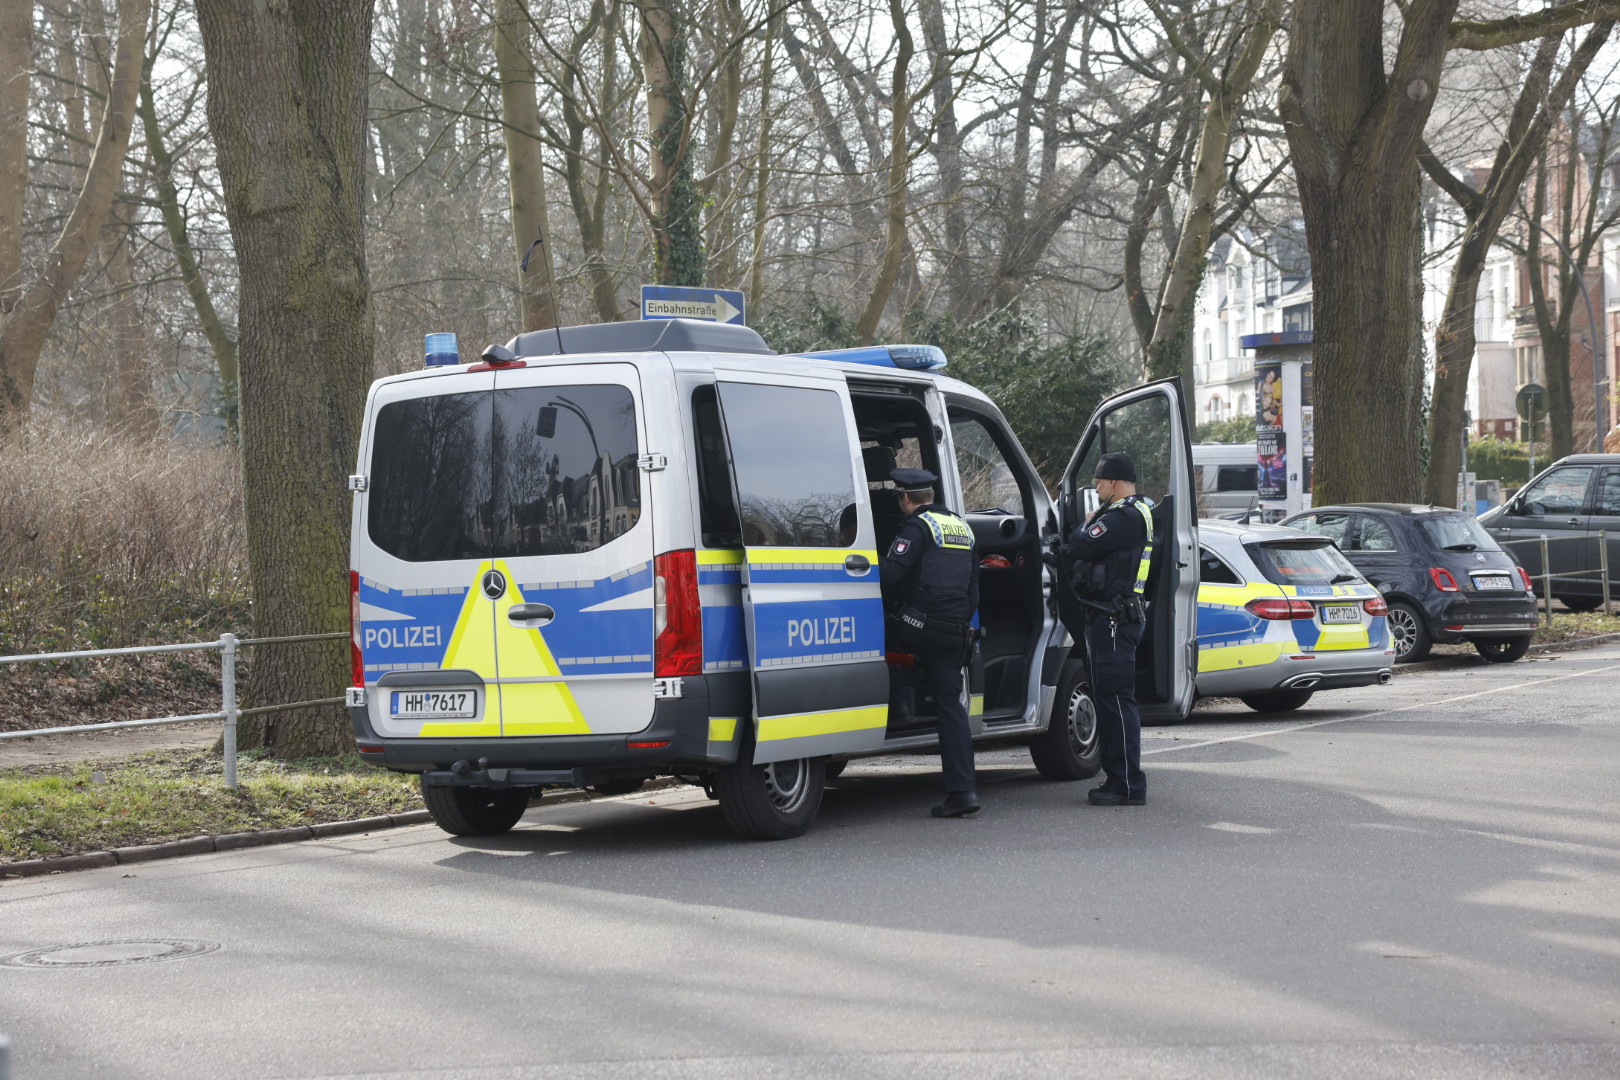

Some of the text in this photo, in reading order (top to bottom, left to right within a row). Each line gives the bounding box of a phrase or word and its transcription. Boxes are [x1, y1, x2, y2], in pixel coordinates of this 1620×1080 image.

[648, 303, 717, 315] Einbahnstraße
[941, 524, 967, 536] POLIZEI
[1303, 586, 1328, 594] POLIZEI
[1329, 607, 1358, 619] HH 7016
[365, 625, 442, 649] POLIZEI
[787, 616, 856, 647] POLIZEI
[405, 695, 423, 711] HH
[431, 694, 466, 711] 7617
